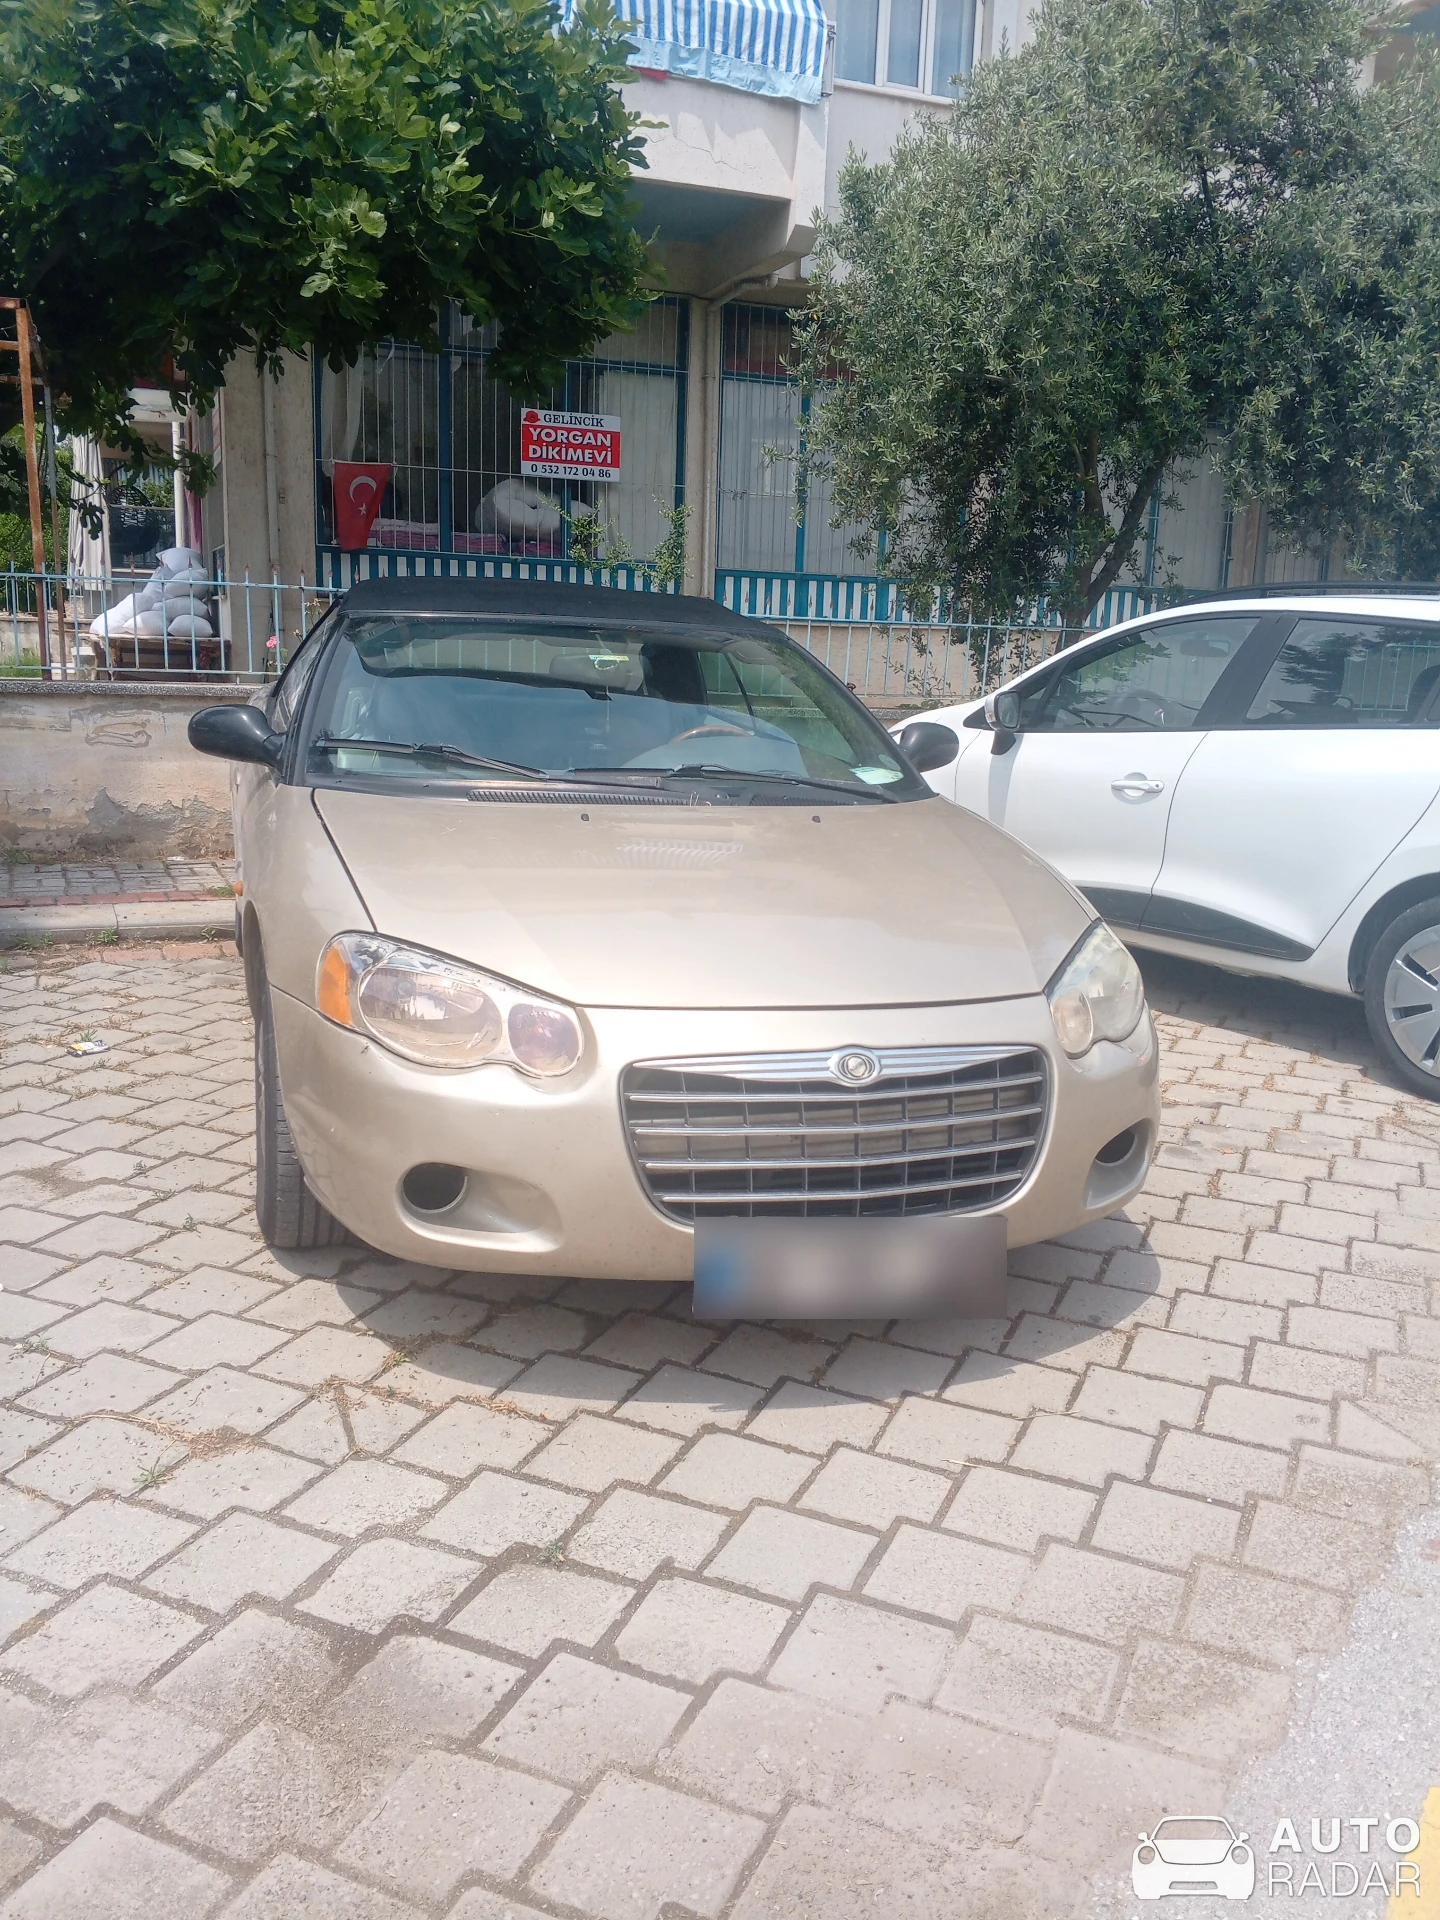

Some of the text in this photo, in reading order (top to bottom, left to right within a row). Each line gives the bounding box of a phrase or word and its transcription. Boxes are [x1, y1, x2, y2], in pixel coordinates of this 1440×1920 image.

[543, 413, 604, 427] GELİNCİK
[528, 427, 612, 447] YORGAN
[528, 442, 612, 464] DİKİMEVİ
[531, 464, 611, 478] 0 532 172 04 86
